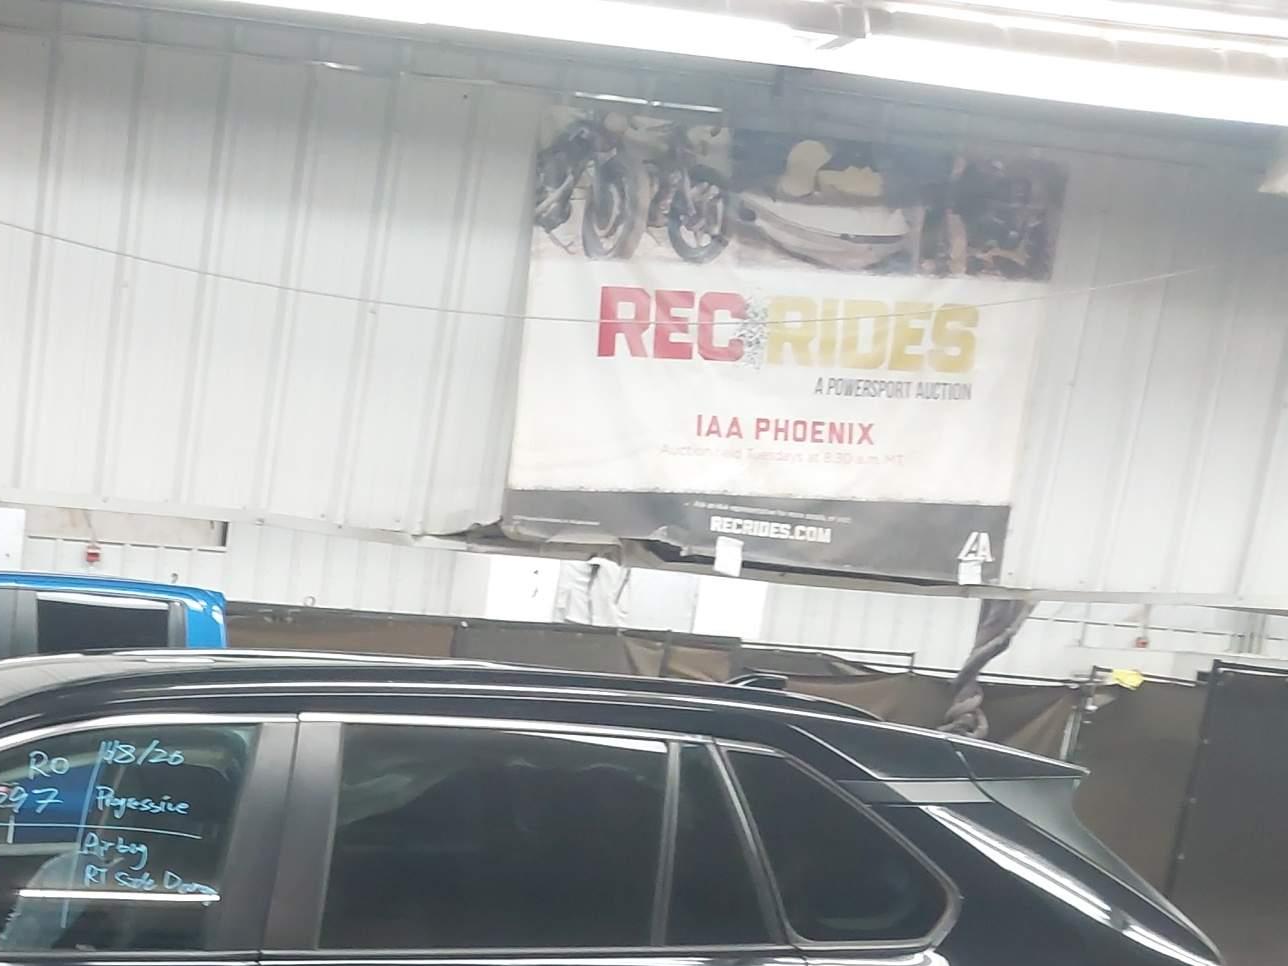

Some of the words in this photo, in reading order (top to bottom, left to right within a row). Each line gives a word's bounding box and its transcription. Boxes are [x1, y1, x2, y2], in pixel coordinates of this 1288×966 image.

[766, 296, 980, 373] RIDES
[815, 378, 823, 395] A
[827, 379, 912, 398] POWERSPORT
[916, 382, 973, 401] AUCTION
[696, 414, 743, 439] IAA
[755, 418, 874, 445] PHOENIX
[711, 516, 832, 543] RECRIDES.COM
